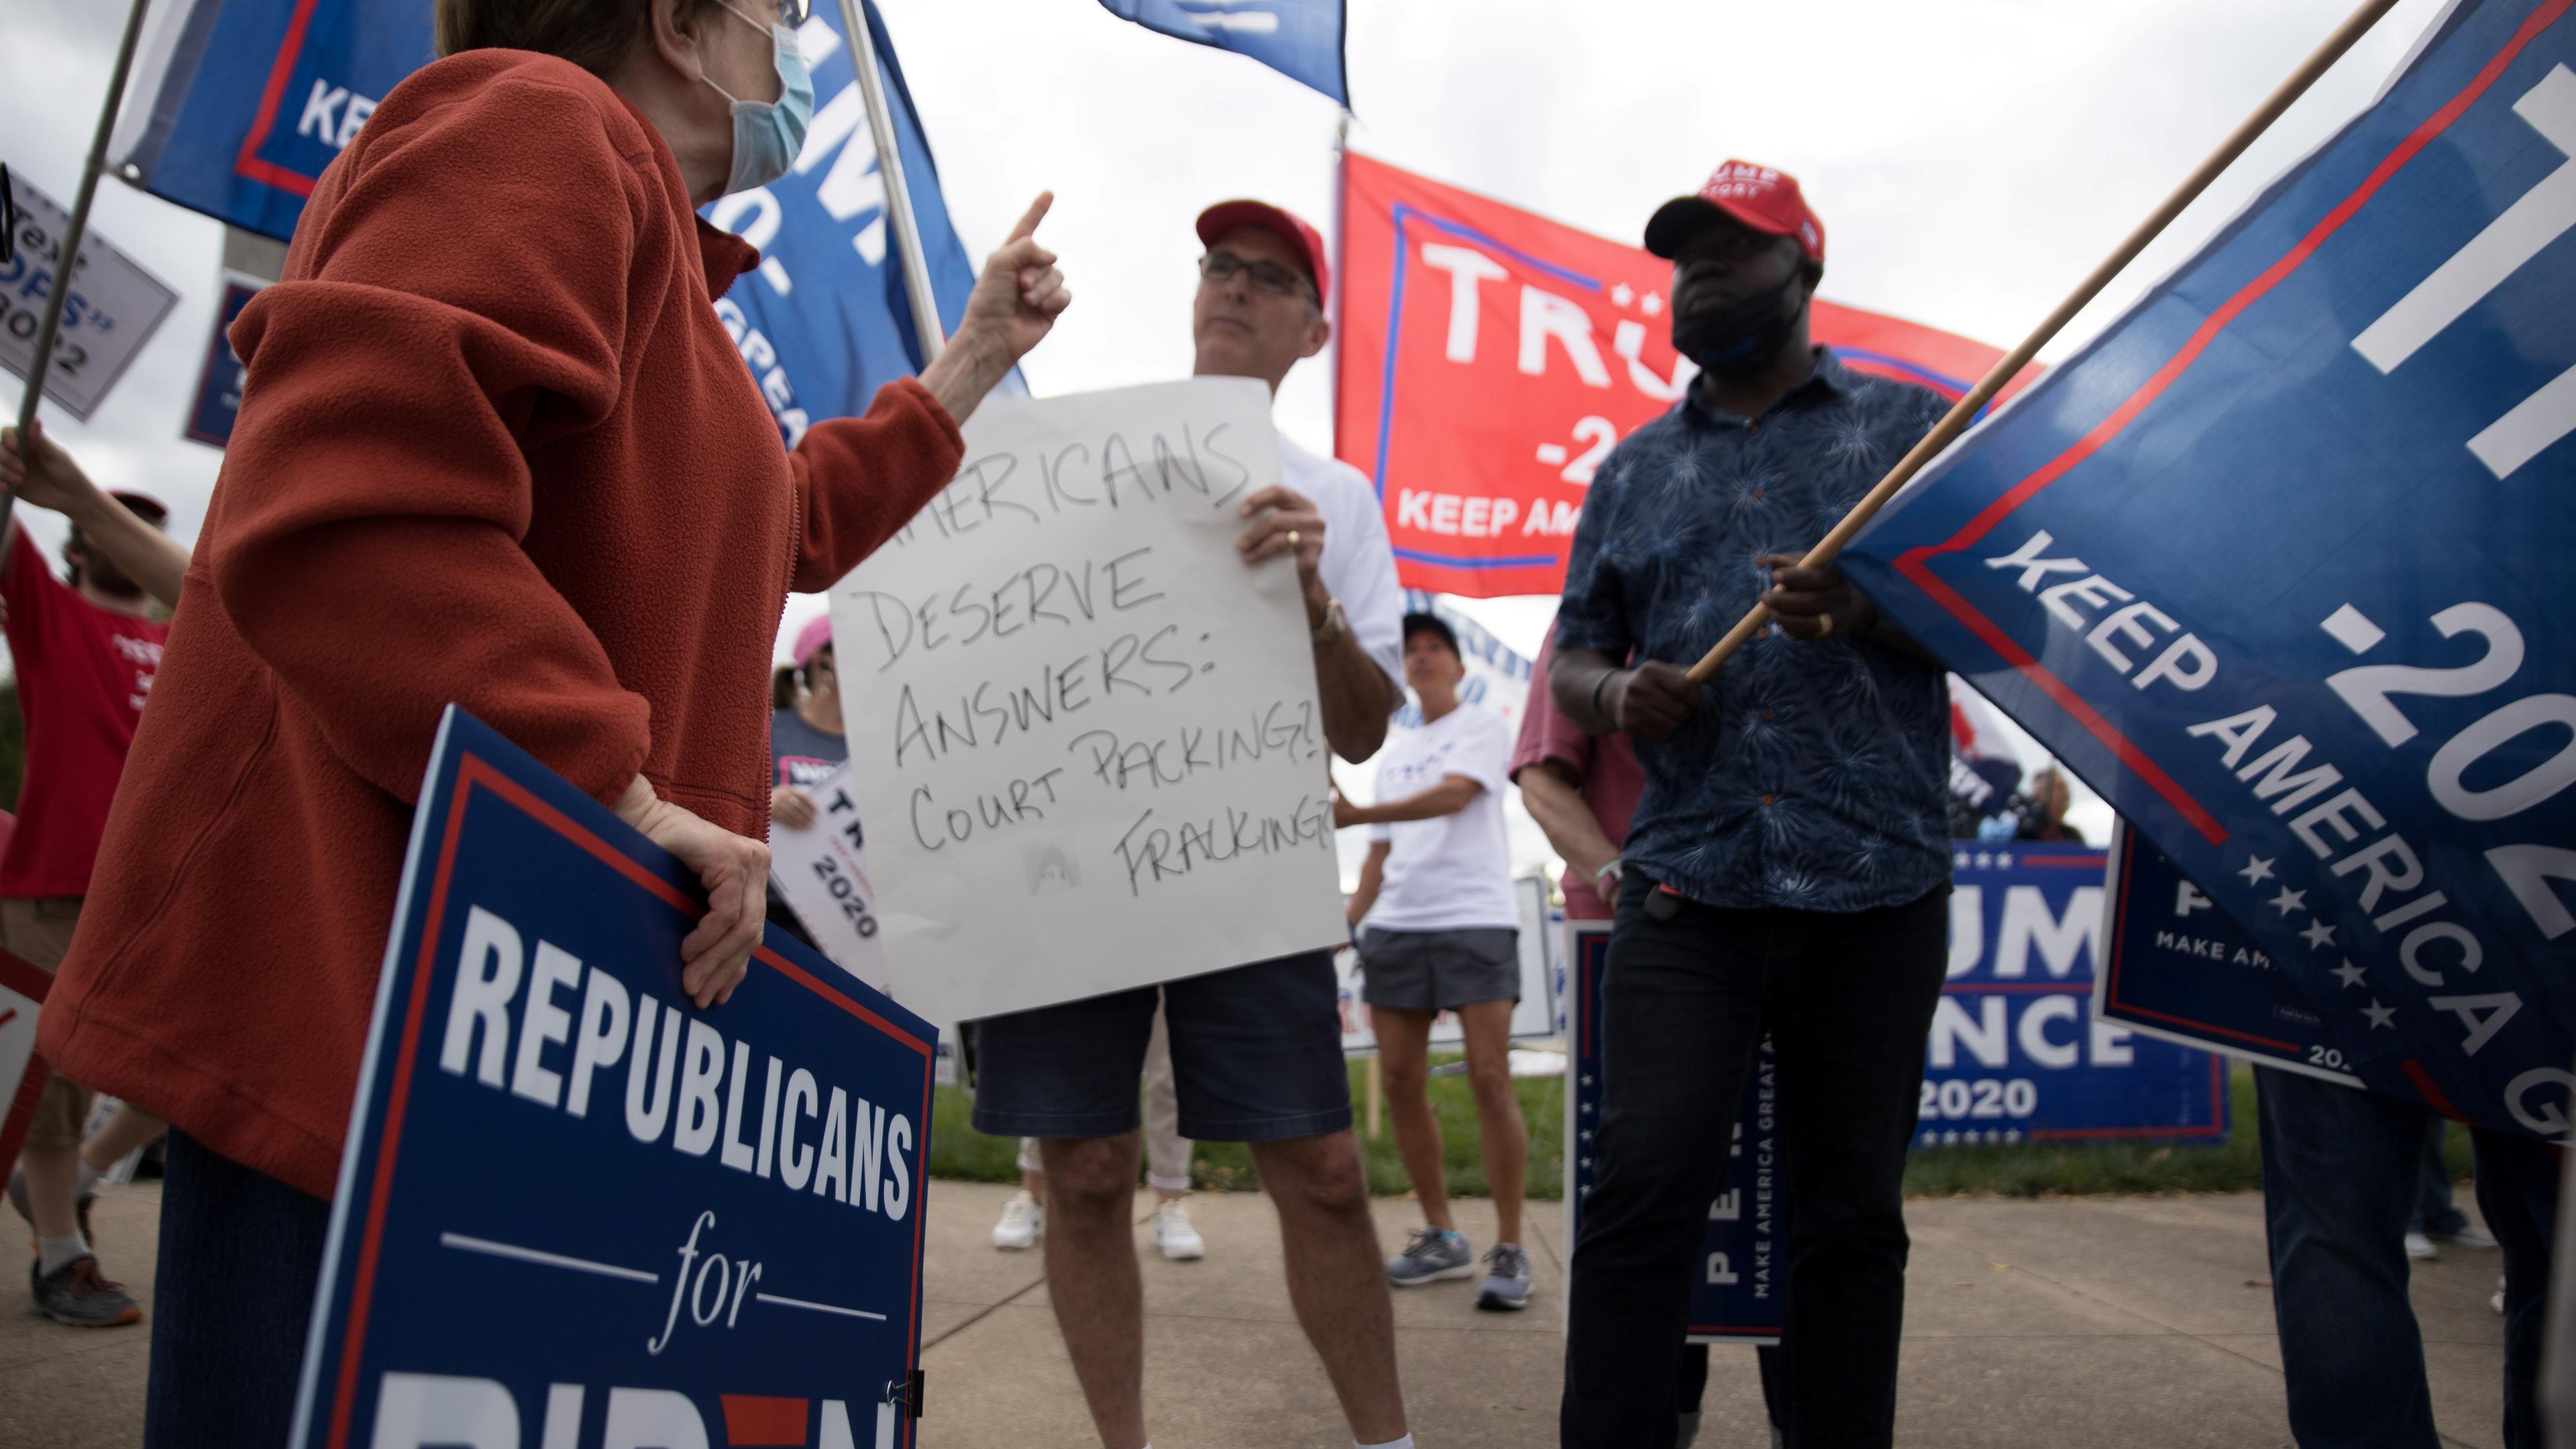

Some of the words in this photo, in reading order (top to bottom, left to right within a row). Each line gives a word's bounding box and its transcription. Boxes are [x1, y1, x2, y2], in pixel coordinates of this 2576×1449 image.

[892, 421, 1252, 549] ERICANS
[1535, 415, 1618, 487] -2
[1397, 487, 1519, 537] KEEP
[851, 546, 1166, 673] DESERVE
[894, 624, 1217, 768] ANSWERS:
[909, 767, 1064, 852] COURT
[1068, 699, 1320, 790] PACKING?
[1984, 529, 2218, 692] KEEP
[2186, 703, 2524, 1057] AMERICA
[1112, 793, 1335, 898] FRACKING?
[810, 854, 878, 940] 2020
[2155, 930, 2226, 961] MAKE
[2233, 946, 2277, 971] AM
[439, 904, 913, 1222] REPUBLICANS
[1758, 1060, 1777, 1131] GREAT
[1919, 1079, 2038, 1120] 2020
[1756, 1137, 1775, 1235] AMERICA
[647, 1210, 762, 1356] for
[1754, 1240, 1773, 1300] MAKE
